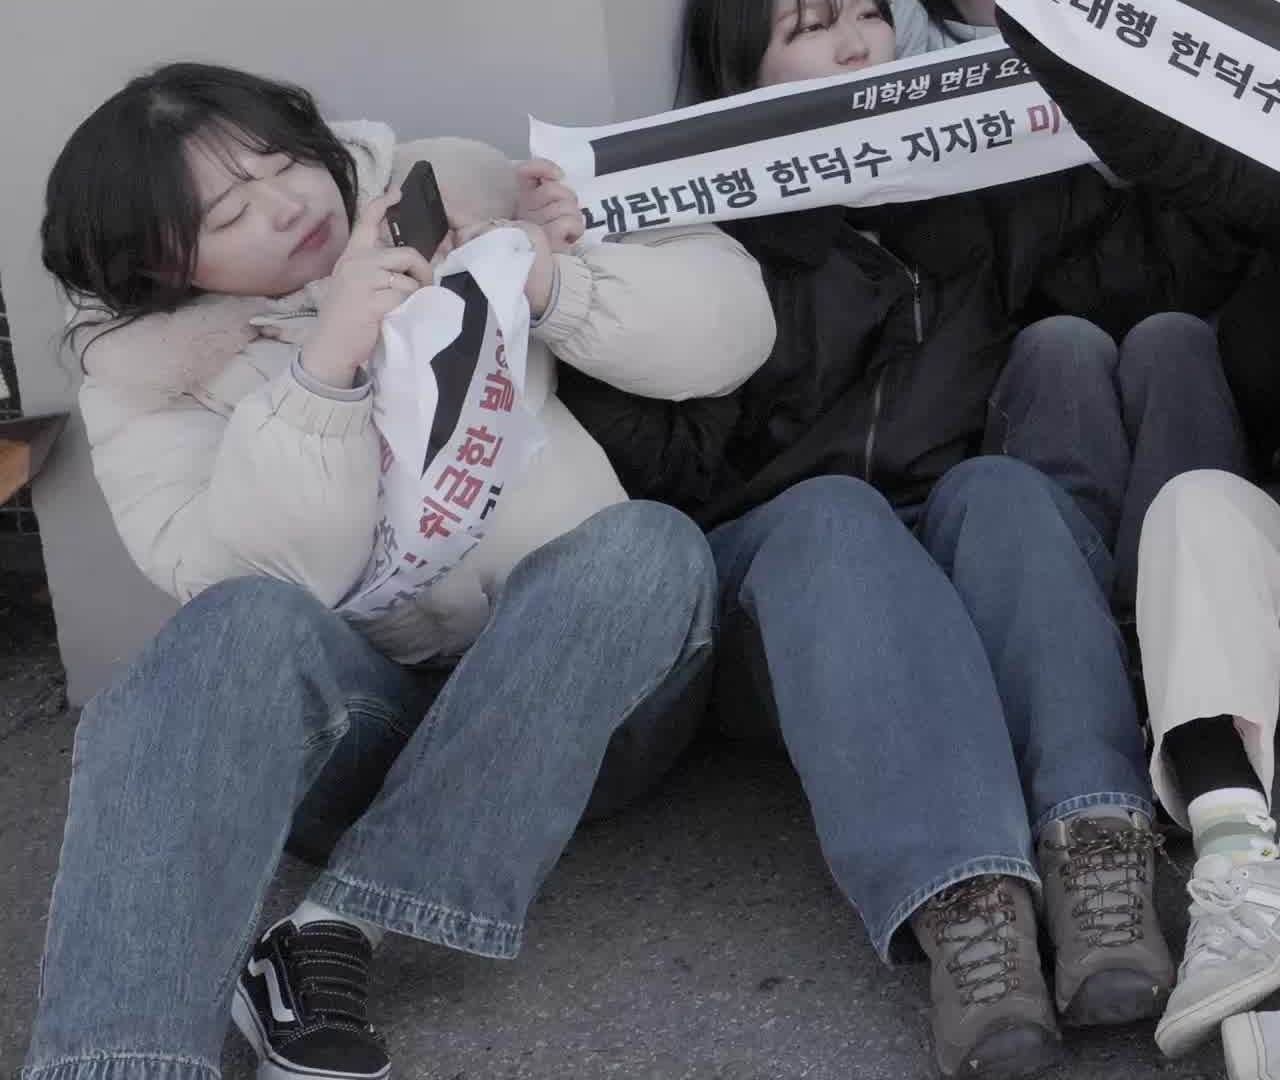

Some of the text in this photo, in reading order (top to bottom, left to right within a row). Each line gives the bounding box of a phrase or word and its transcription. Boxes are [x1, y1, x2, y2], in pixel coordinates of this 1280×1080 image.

[852, 76, 933, 112] 대학생
[940, 61, 991, 93] 면담
[583, 168, 759, 237] 내란대행
[765, 133, 893, 199] 한덕수
[906, 108, 1016, 165] 지지한
